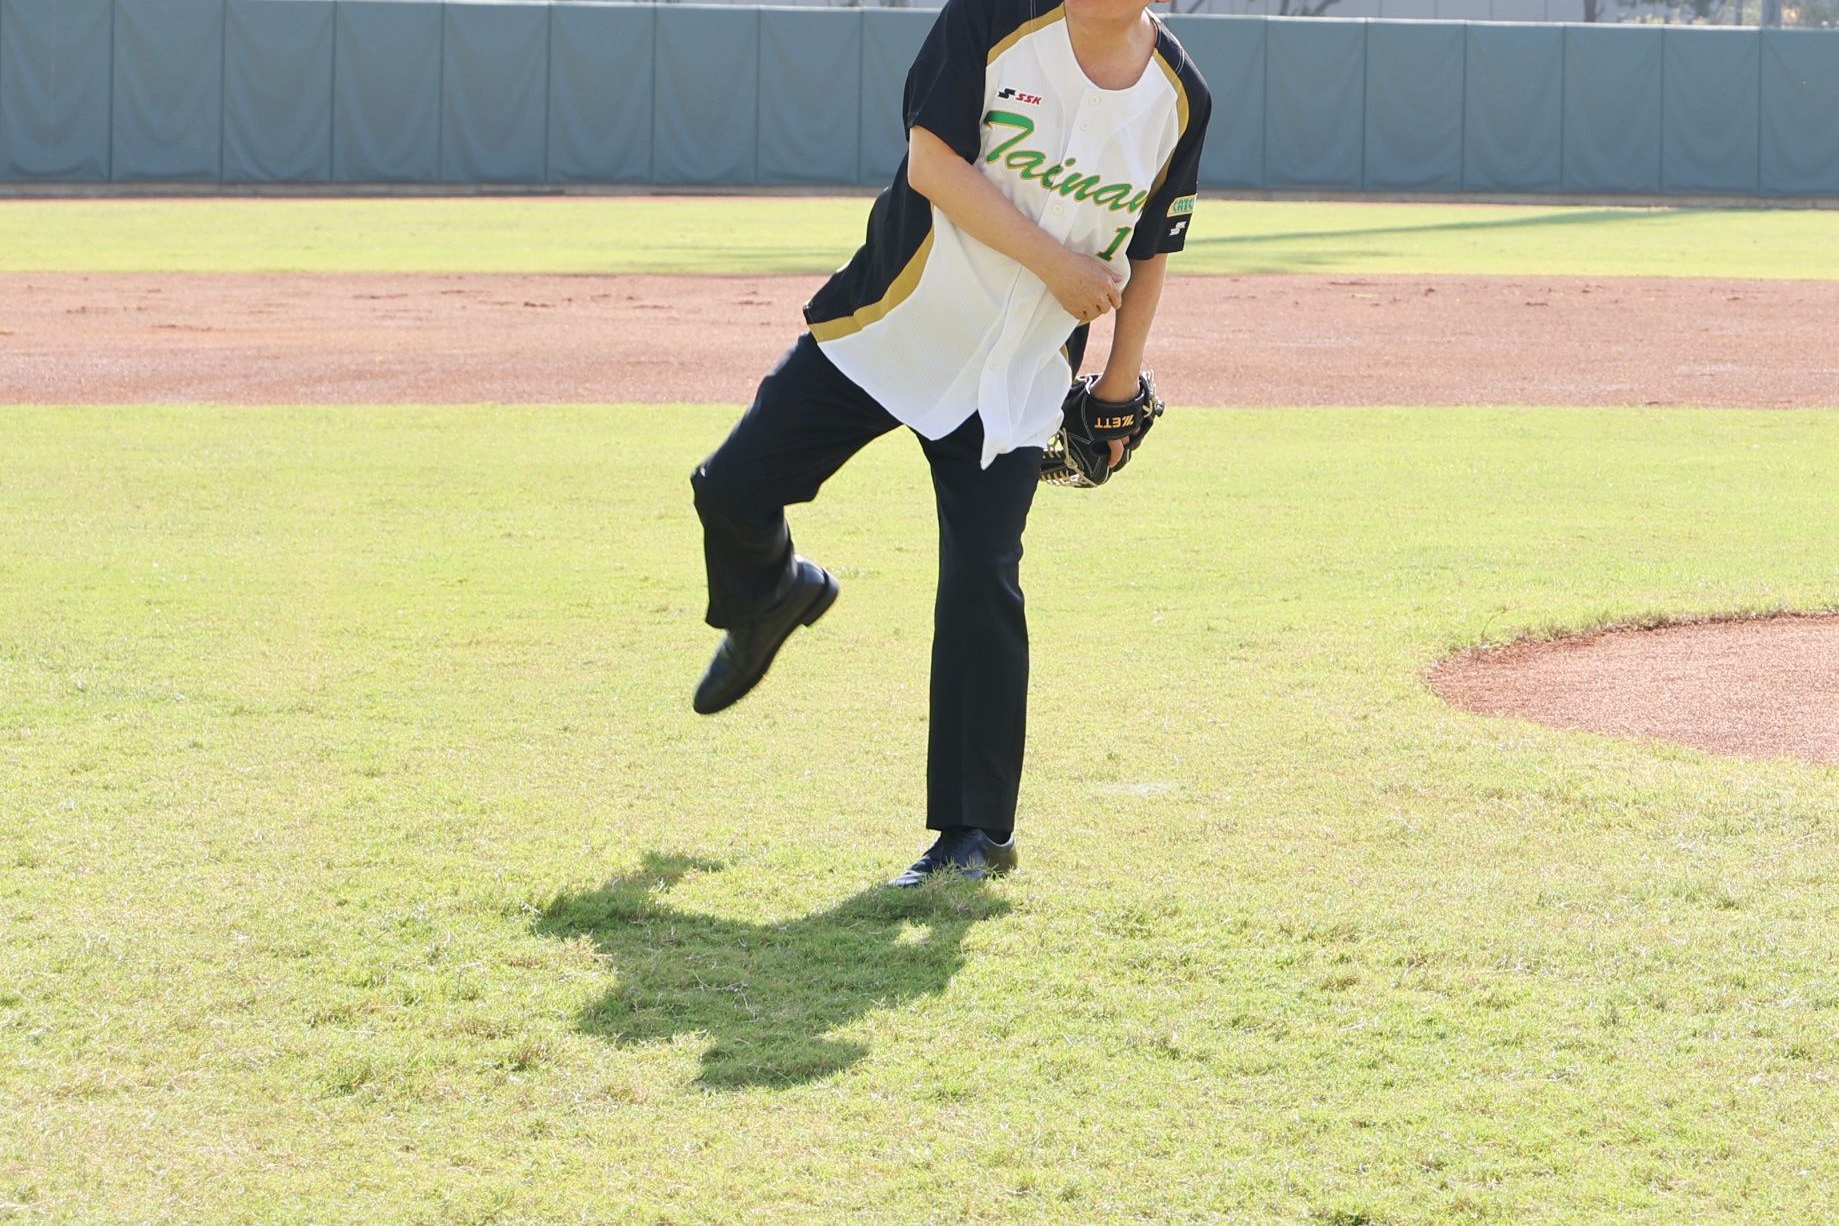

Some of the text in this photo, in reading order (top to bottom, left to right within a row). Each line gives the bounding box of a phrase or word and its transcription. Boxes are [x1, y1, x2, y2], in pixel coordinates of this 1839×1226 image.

[1015, 92, 1042, 105] SSK
[1096, 225, 1133, 262] 1
[1094, 413, 1135, 429] ZETT
